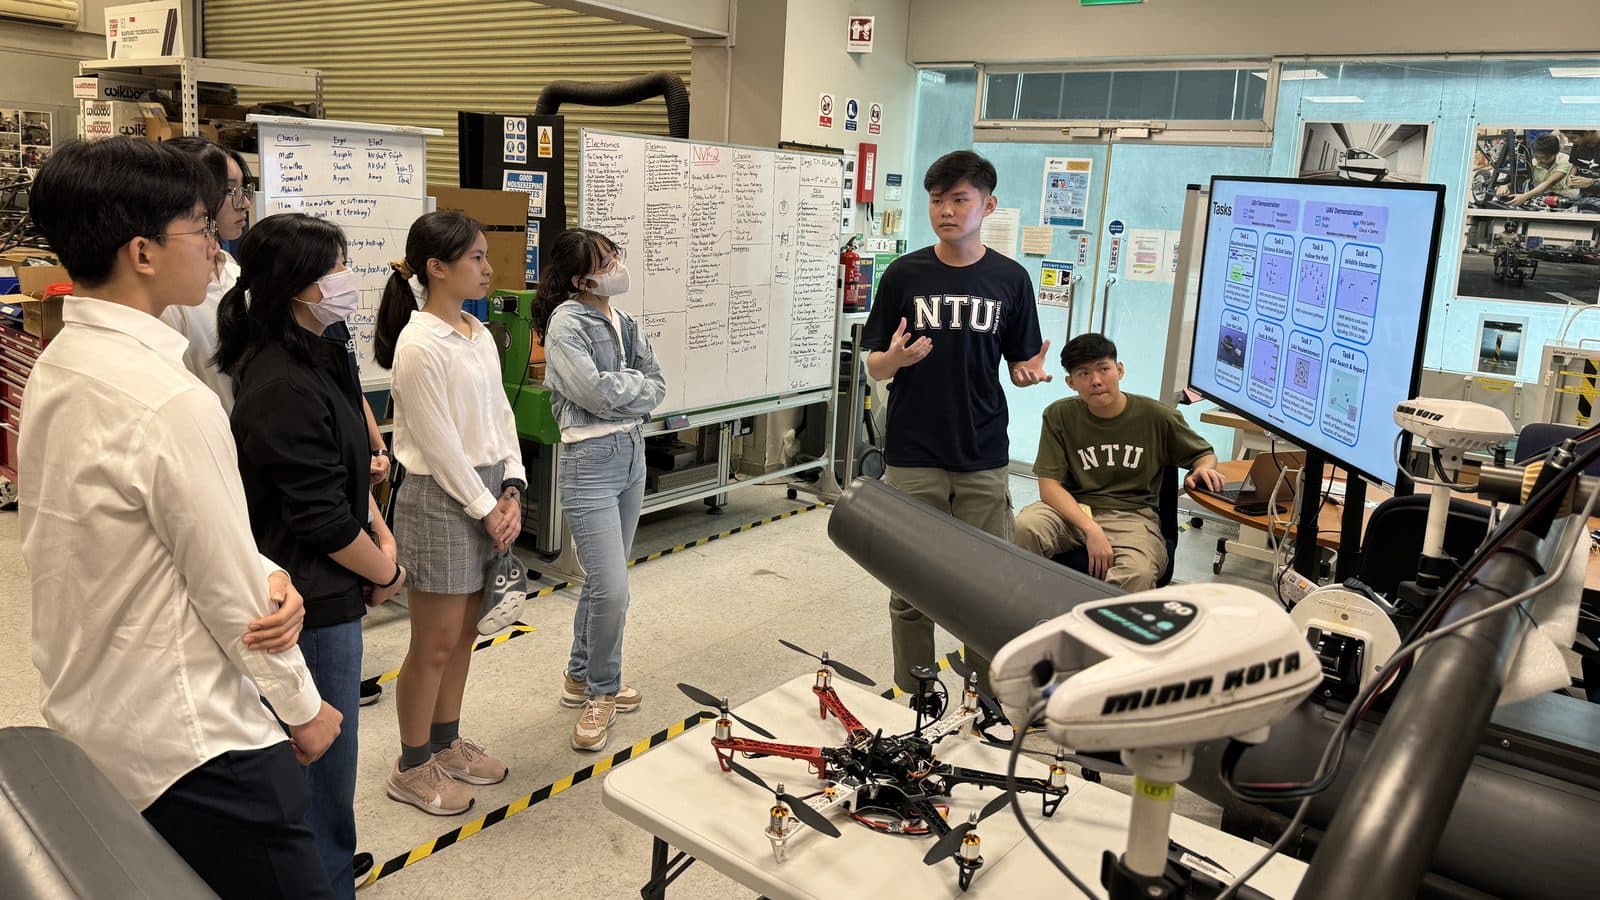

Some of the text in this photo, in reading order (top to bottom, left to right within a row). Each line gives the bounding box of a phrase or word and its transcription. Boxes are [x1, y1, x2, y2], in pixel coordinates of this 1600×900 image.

[585, 137, 620, 149] Electronics
[518, 174, 533, 182] GOOD
[1212, 201, 1233, 217] Tasks
[1334, 207, 1364, 216] Demonstration
[1355, 249, 1364, 257] Task
[913, 294, 995, 333] NTU
[1352, 366, 1366, 374] Report
[1077, 443, 1144, 471] NTU
[1222, 651, 1301, 692] KOTA
[1142, 783, 1173, 797] LEFT
